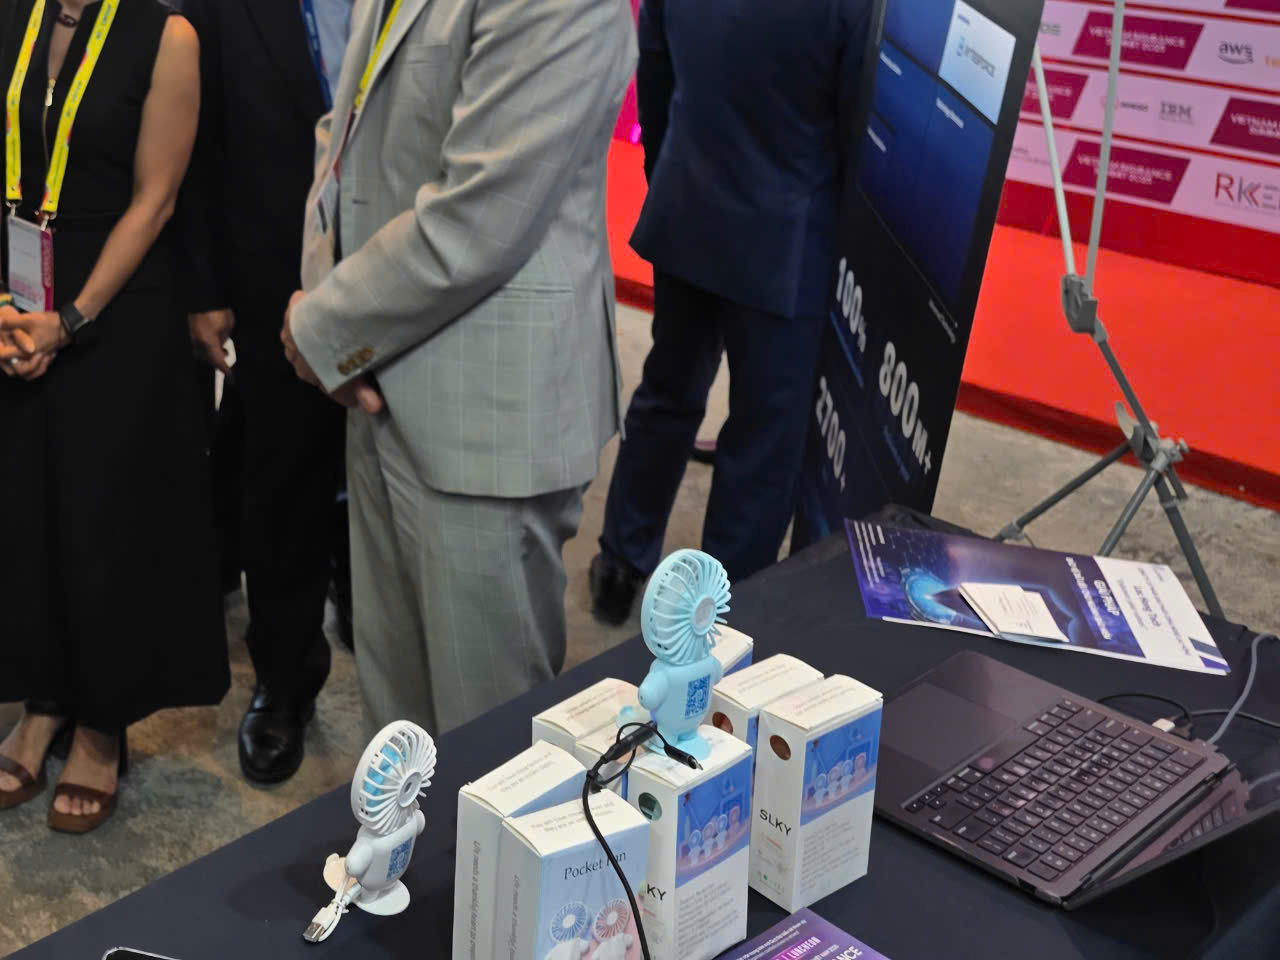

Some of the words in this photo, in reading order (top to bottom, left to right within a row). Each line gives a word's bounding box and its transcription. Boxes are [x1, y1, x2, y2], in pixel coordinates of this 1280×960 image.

[1218, 41, 1253, 58] aws
[1160, 101, 1192, 120] IBM
[759, 808, 792, 836] SLKY
[564, 858, 603, 880] Pocket
[647, 884, 667, 901] KY
